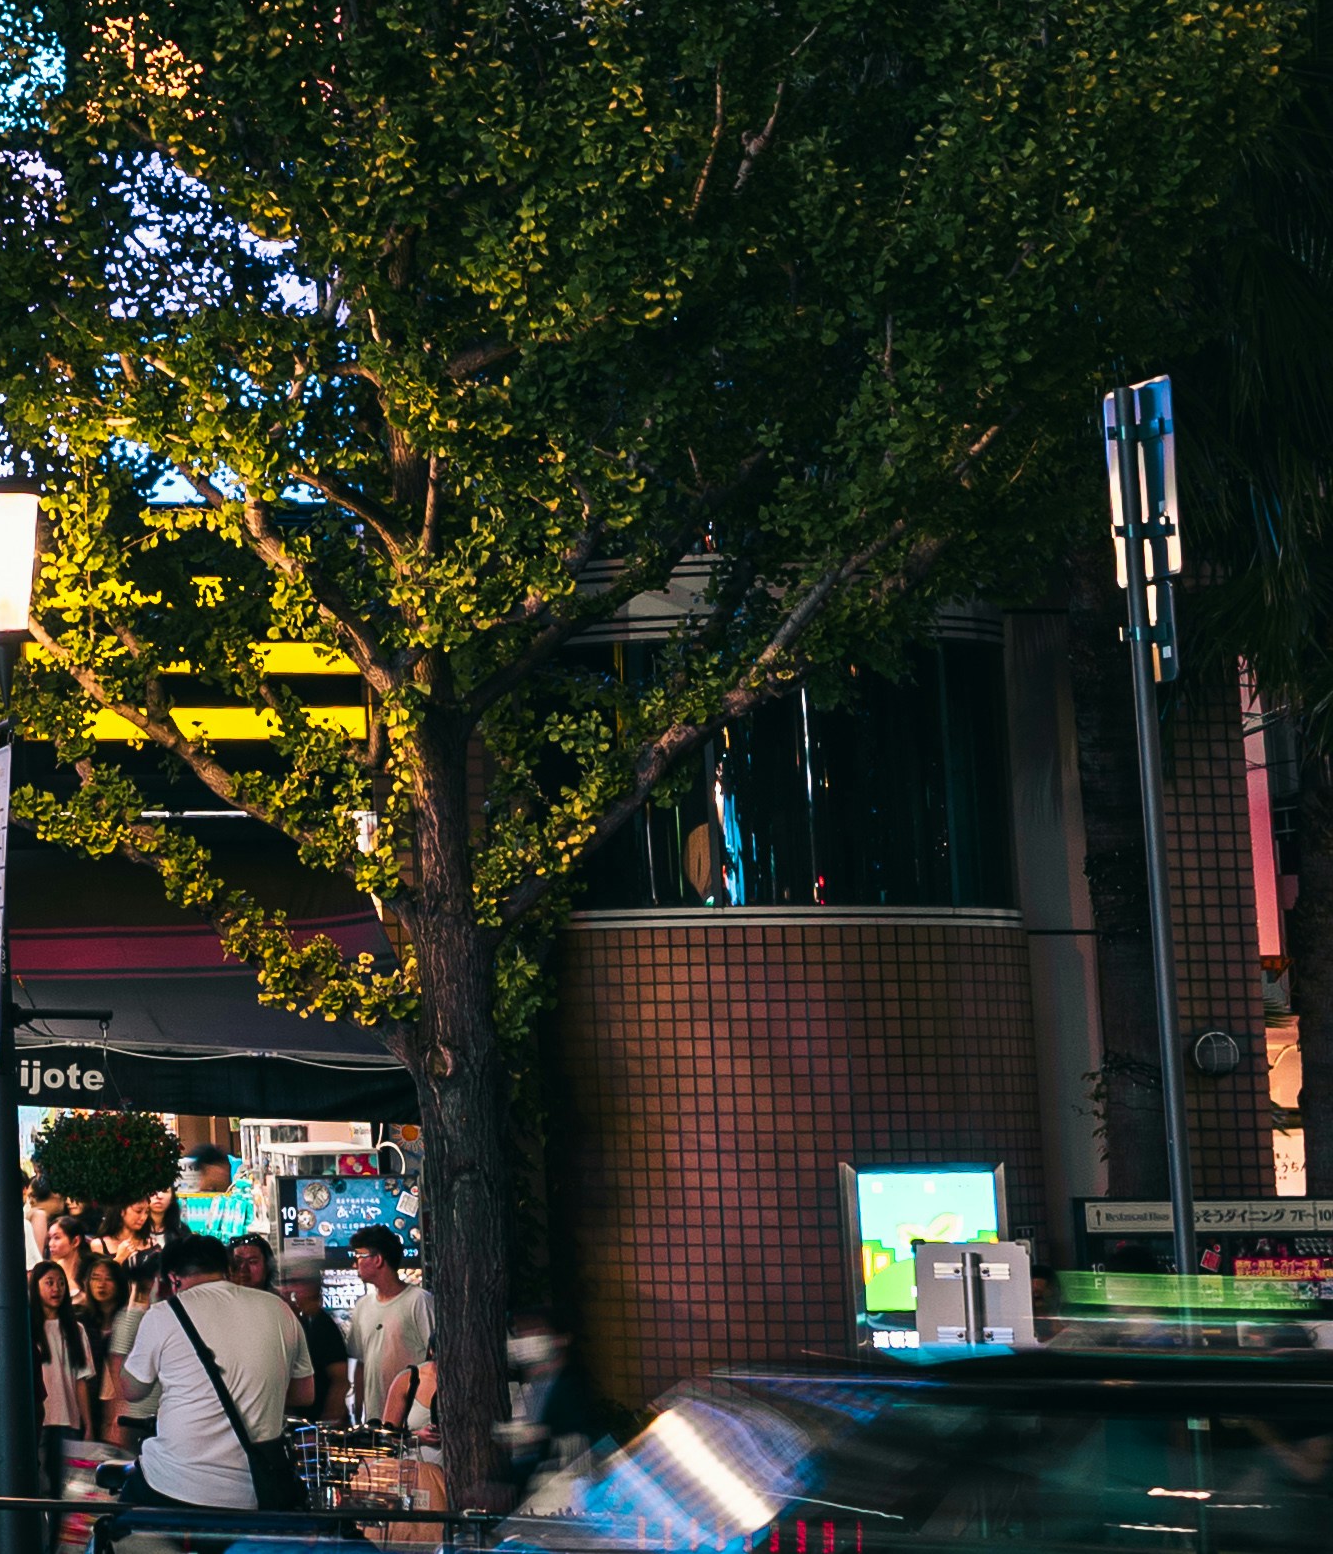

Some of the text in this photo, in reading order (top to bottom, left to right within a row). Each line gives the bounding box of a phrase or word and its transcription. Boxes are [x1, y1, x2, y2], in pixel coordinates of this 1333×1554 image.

[281, 1206, 297, 1221] 10
[284, 1223, 294, 1236] F
[322, 1295, 358, 1308] NEXT
